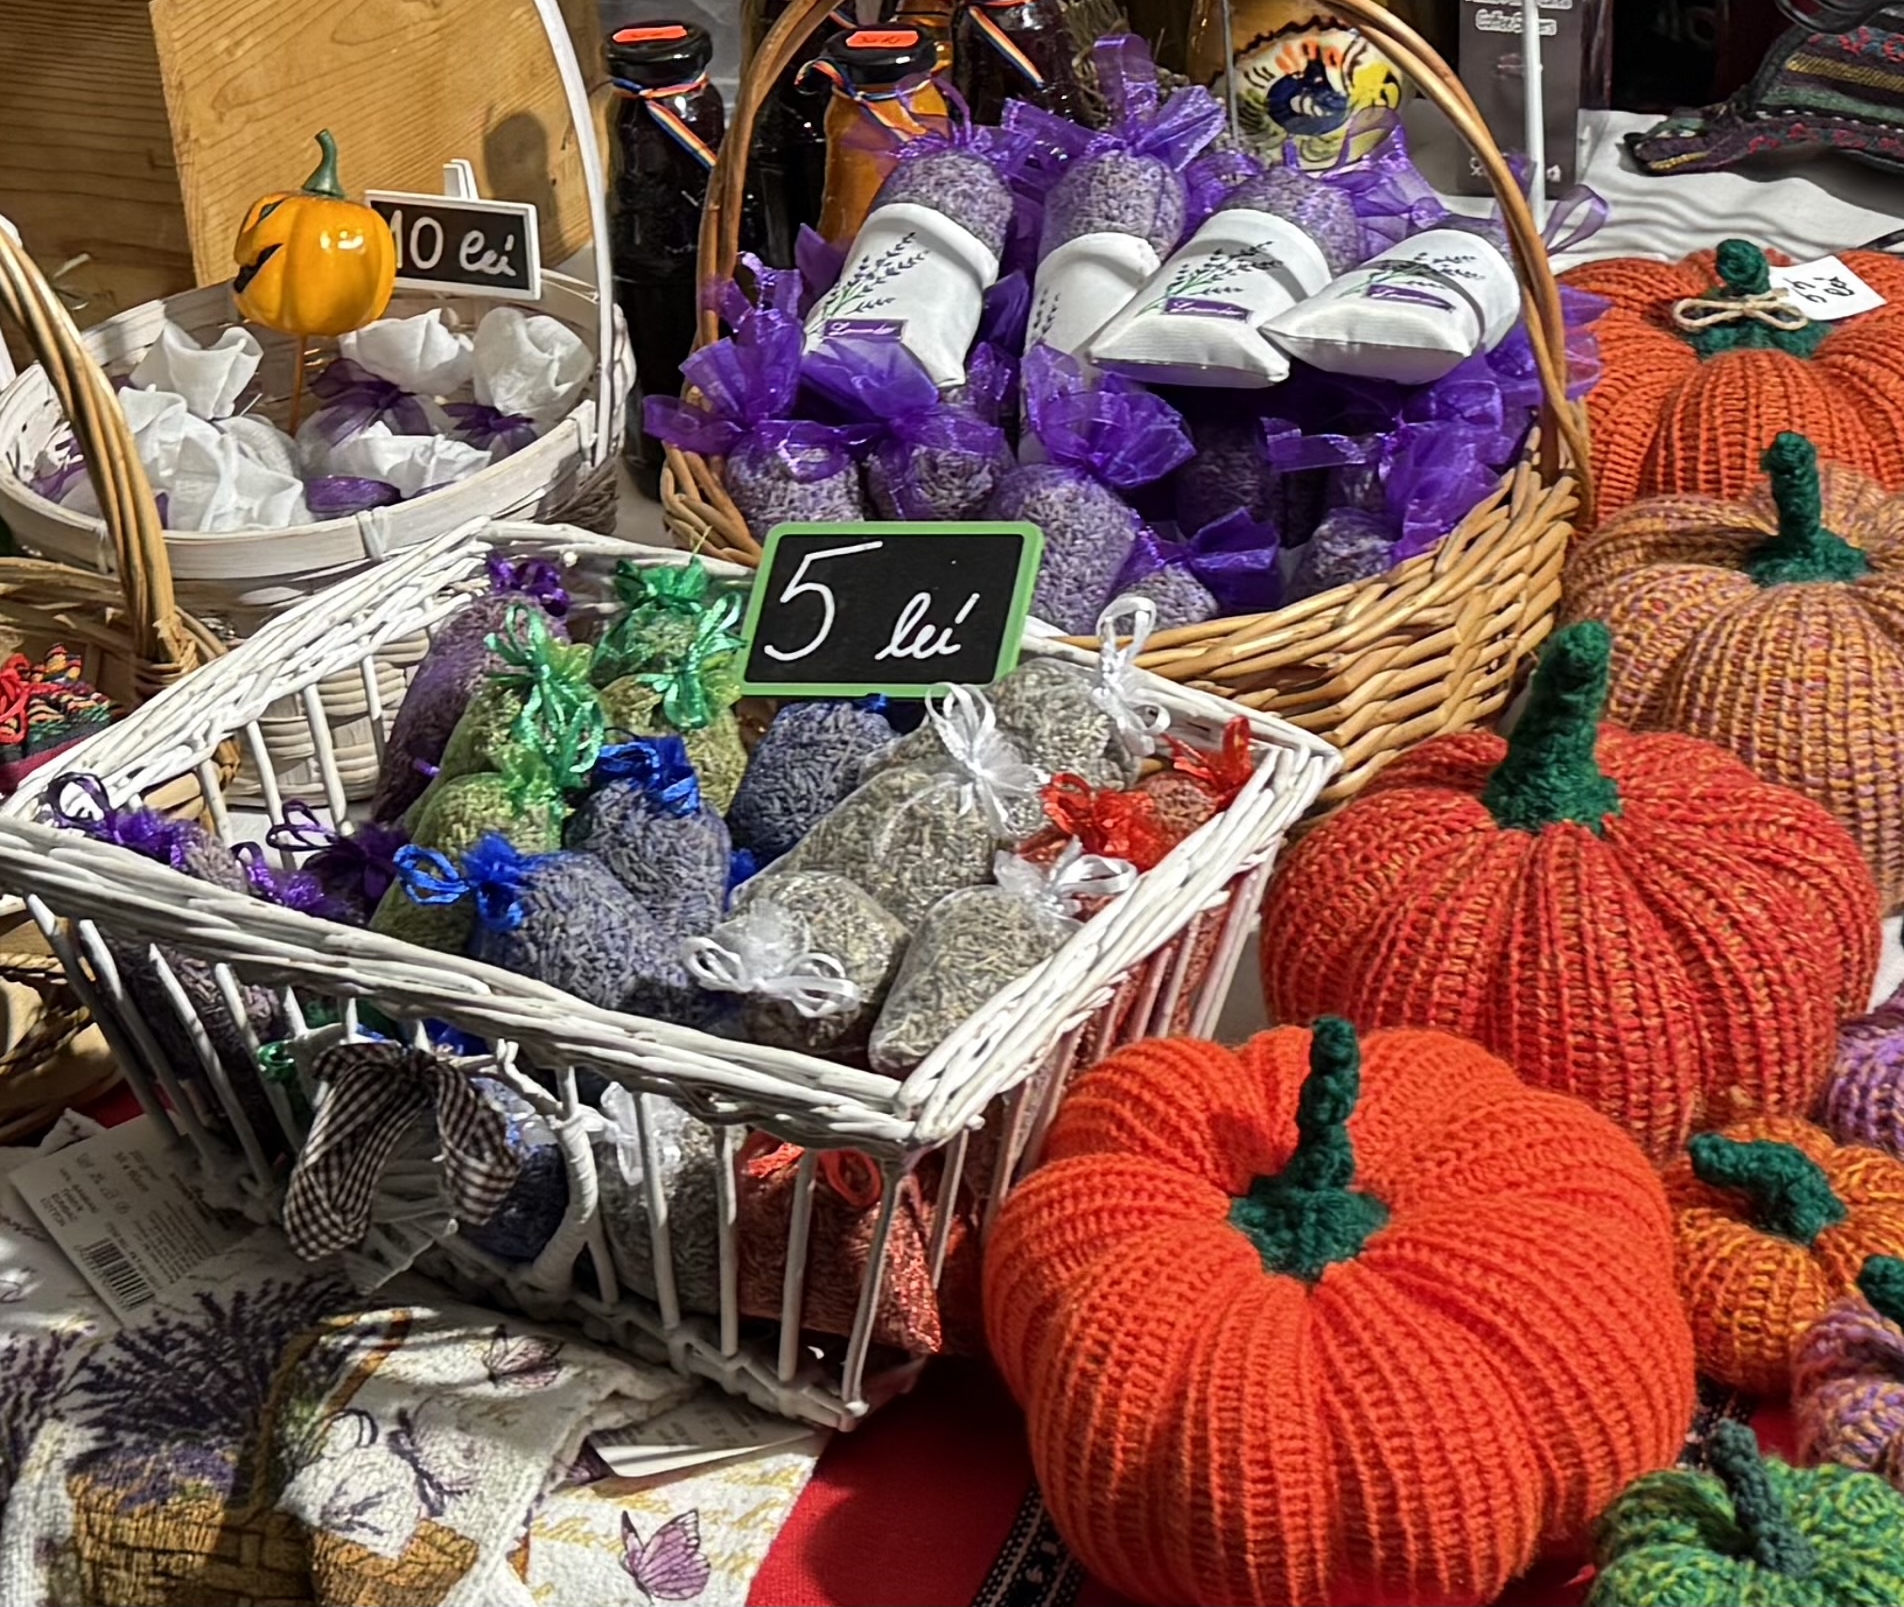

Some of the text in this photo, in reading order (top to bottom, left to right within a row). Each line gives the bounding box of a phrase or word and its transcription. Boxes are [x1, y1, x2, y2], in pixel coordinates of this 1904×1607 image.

[389, 209, 517, 277] 10 lei
[763, 540, 981, 662] 5 lei
